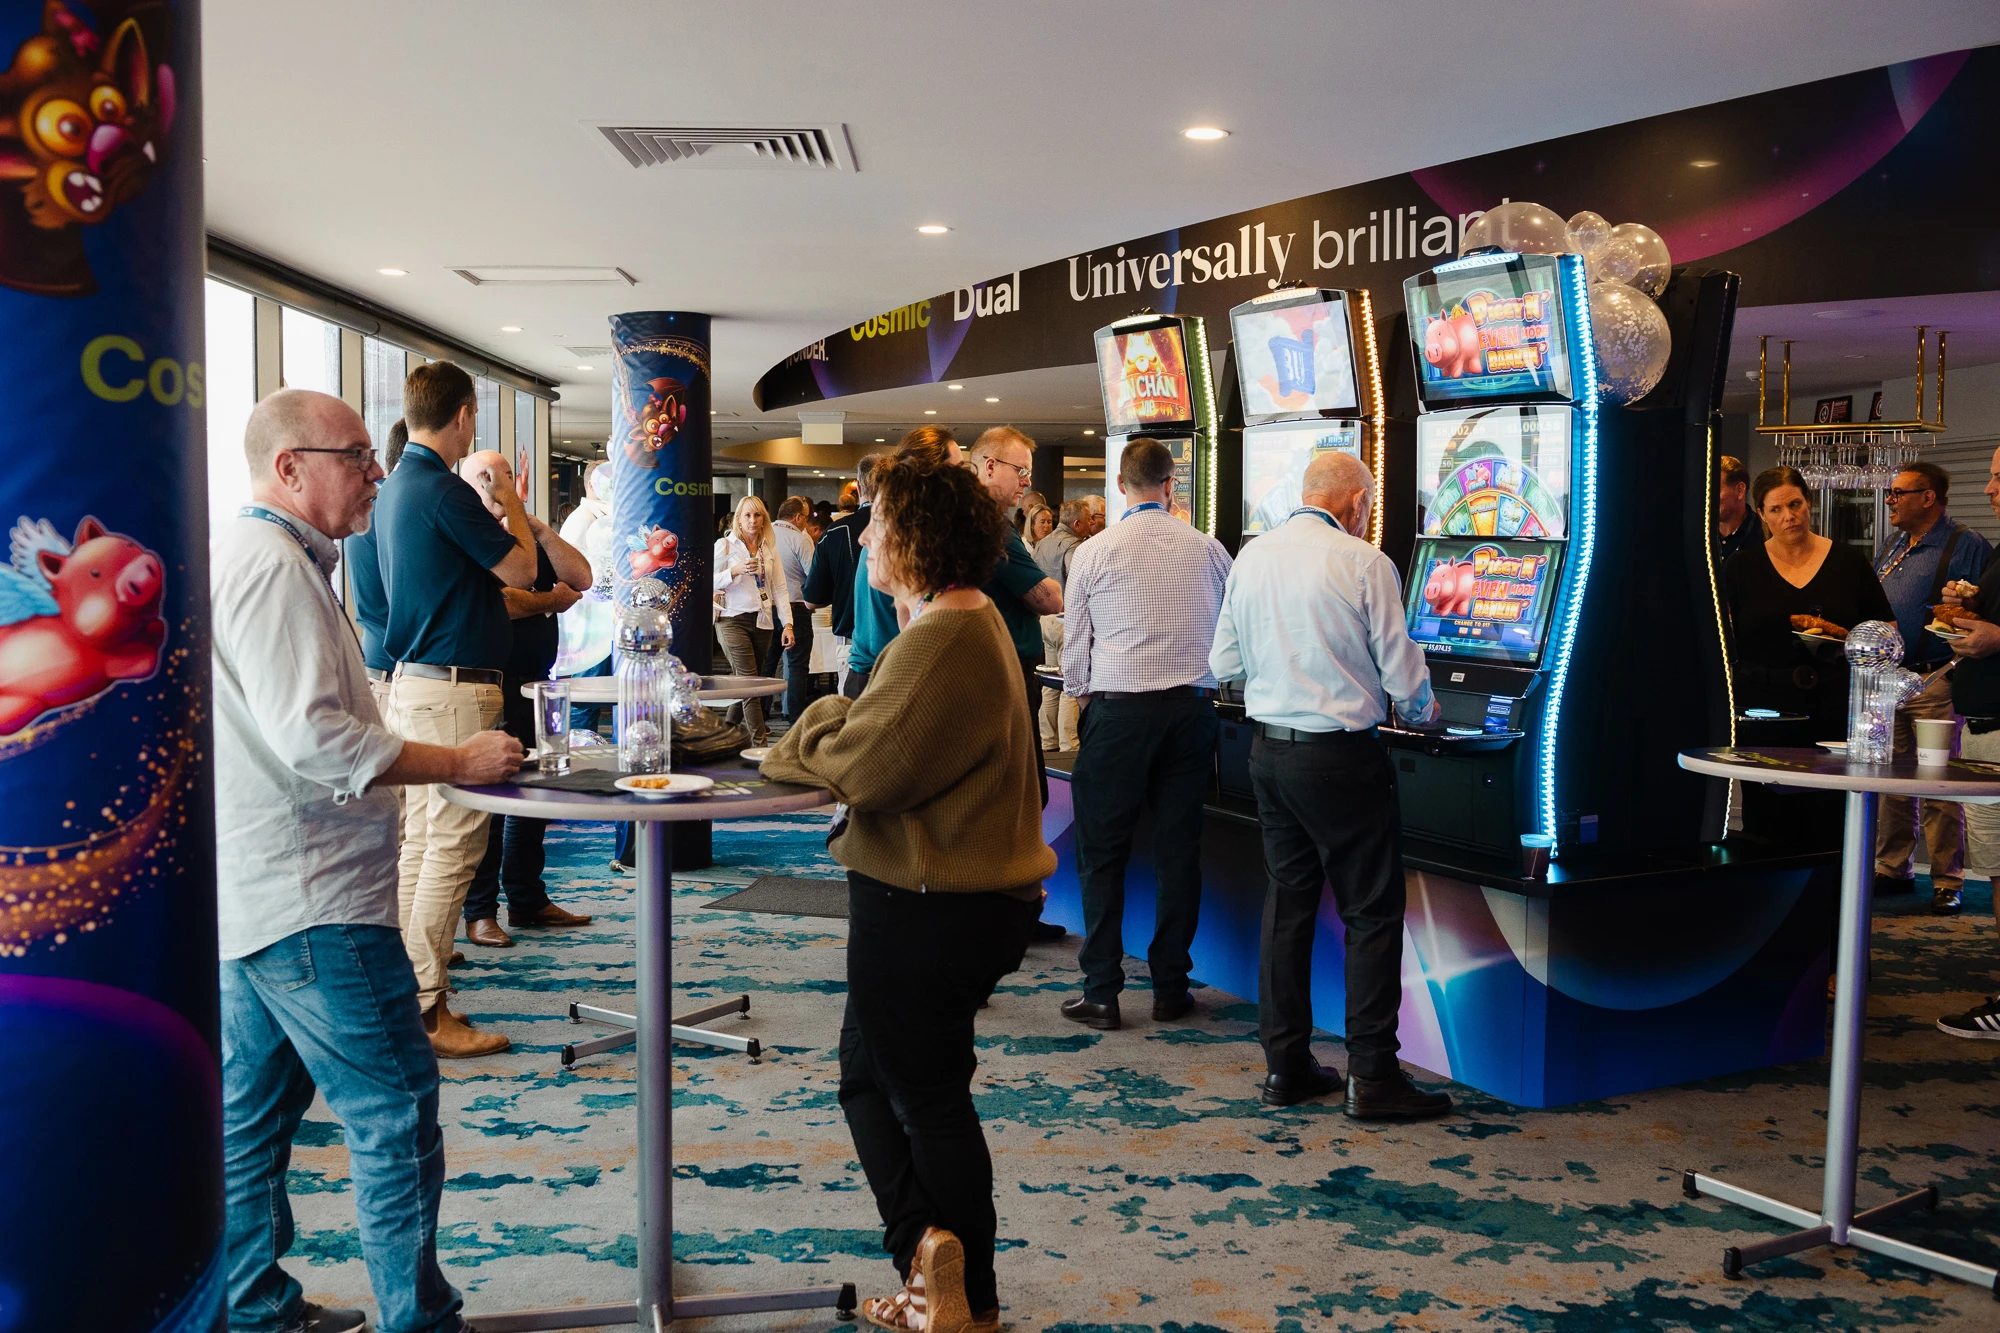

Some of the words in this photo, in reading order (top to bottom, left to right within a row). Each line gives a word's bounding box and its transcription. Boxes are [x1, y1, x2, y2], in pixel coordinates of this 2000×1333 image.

[1067, 221, 1297, 302] Universally
[953, 271, 1021, 322] Dual
[1477, 324, 1521, 349] EVEN
[1521, 324, 1549, 340] MORE
[1471, 579, 1511, 599] EVEN
[1511, 583, 1536, 597] MORE
